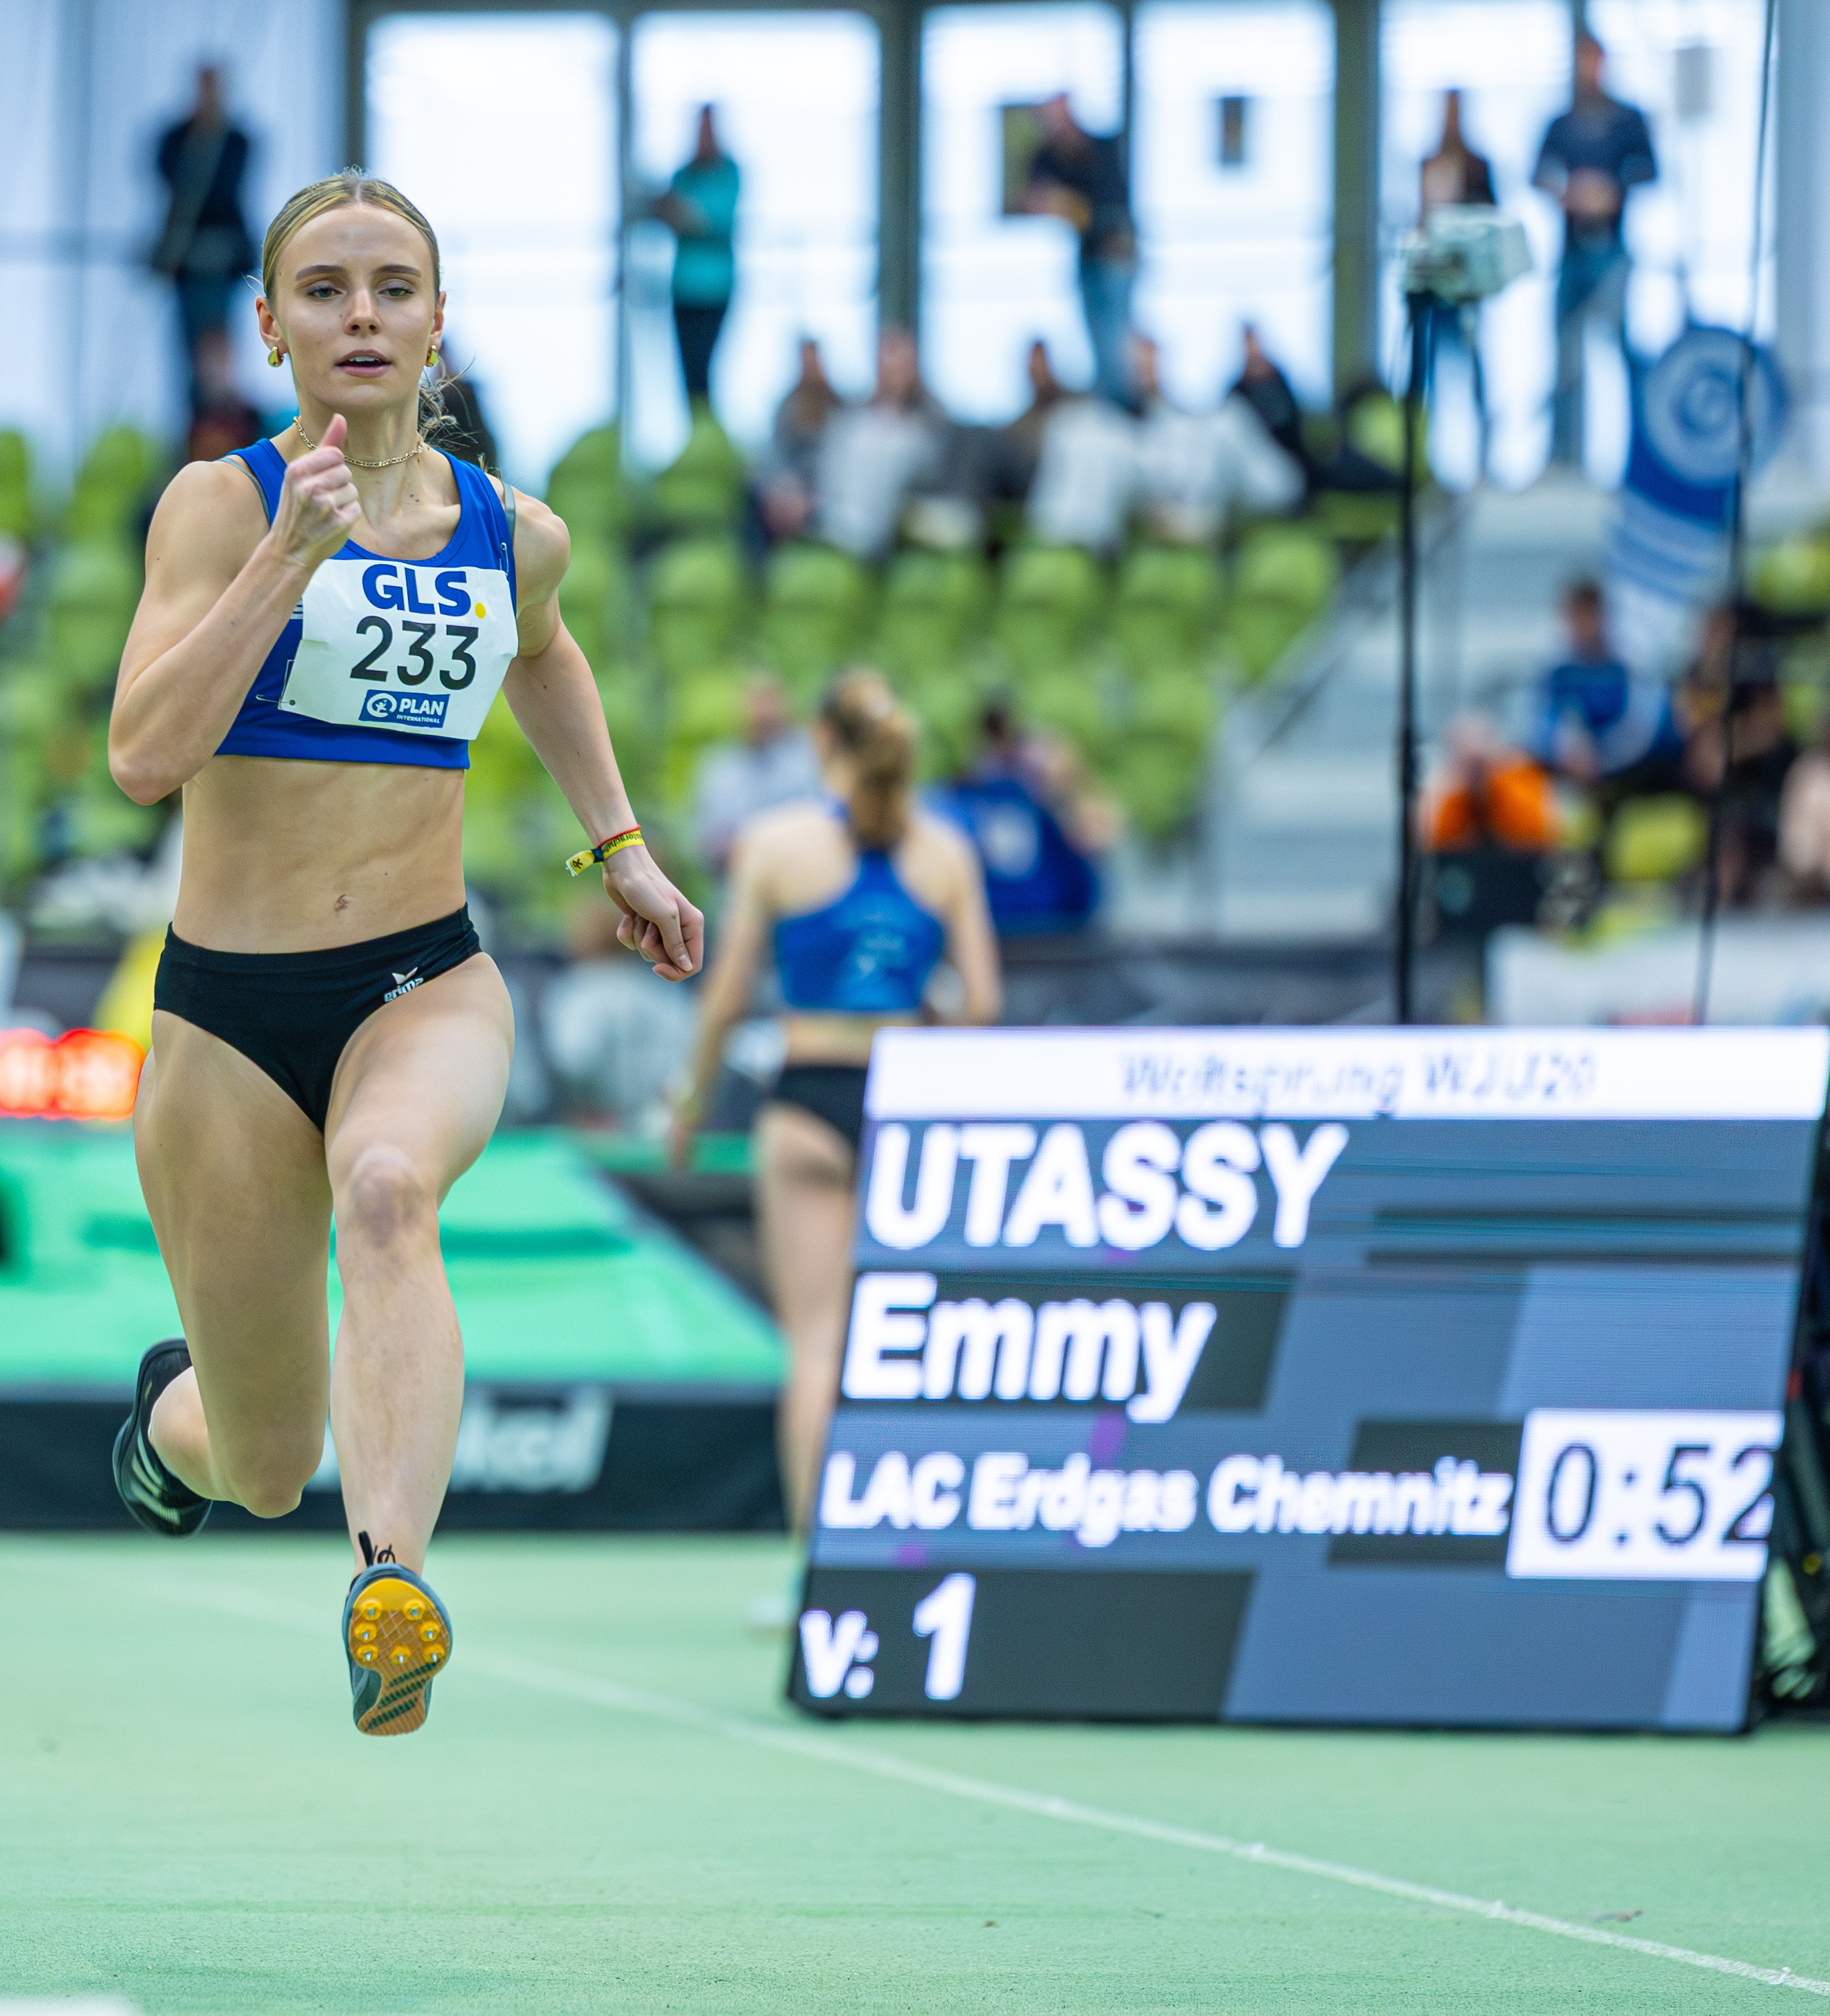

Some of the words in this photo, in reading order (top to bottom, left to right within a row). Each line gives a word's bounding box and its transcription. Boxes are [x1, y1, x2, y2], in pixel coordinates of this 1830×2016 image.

[350, 615, 479, 691] 233
[396, 714, 441, 724] INTERNATIONAL
[399, 698, 445, 716] PLAN
[865, 1121, 1349, 1251] UTASSY
[841, 1271, 1218, 1424] Emmy
[819, 1450, 965, 1529] LAC
[967, 1451, 1199, 1548] Erdgas
[1206, 1453, 1513, 1535] Chemnitz
[1546, 1442, 1776, 1545] 0:52
[912, 1571, 977, 1700] 1
